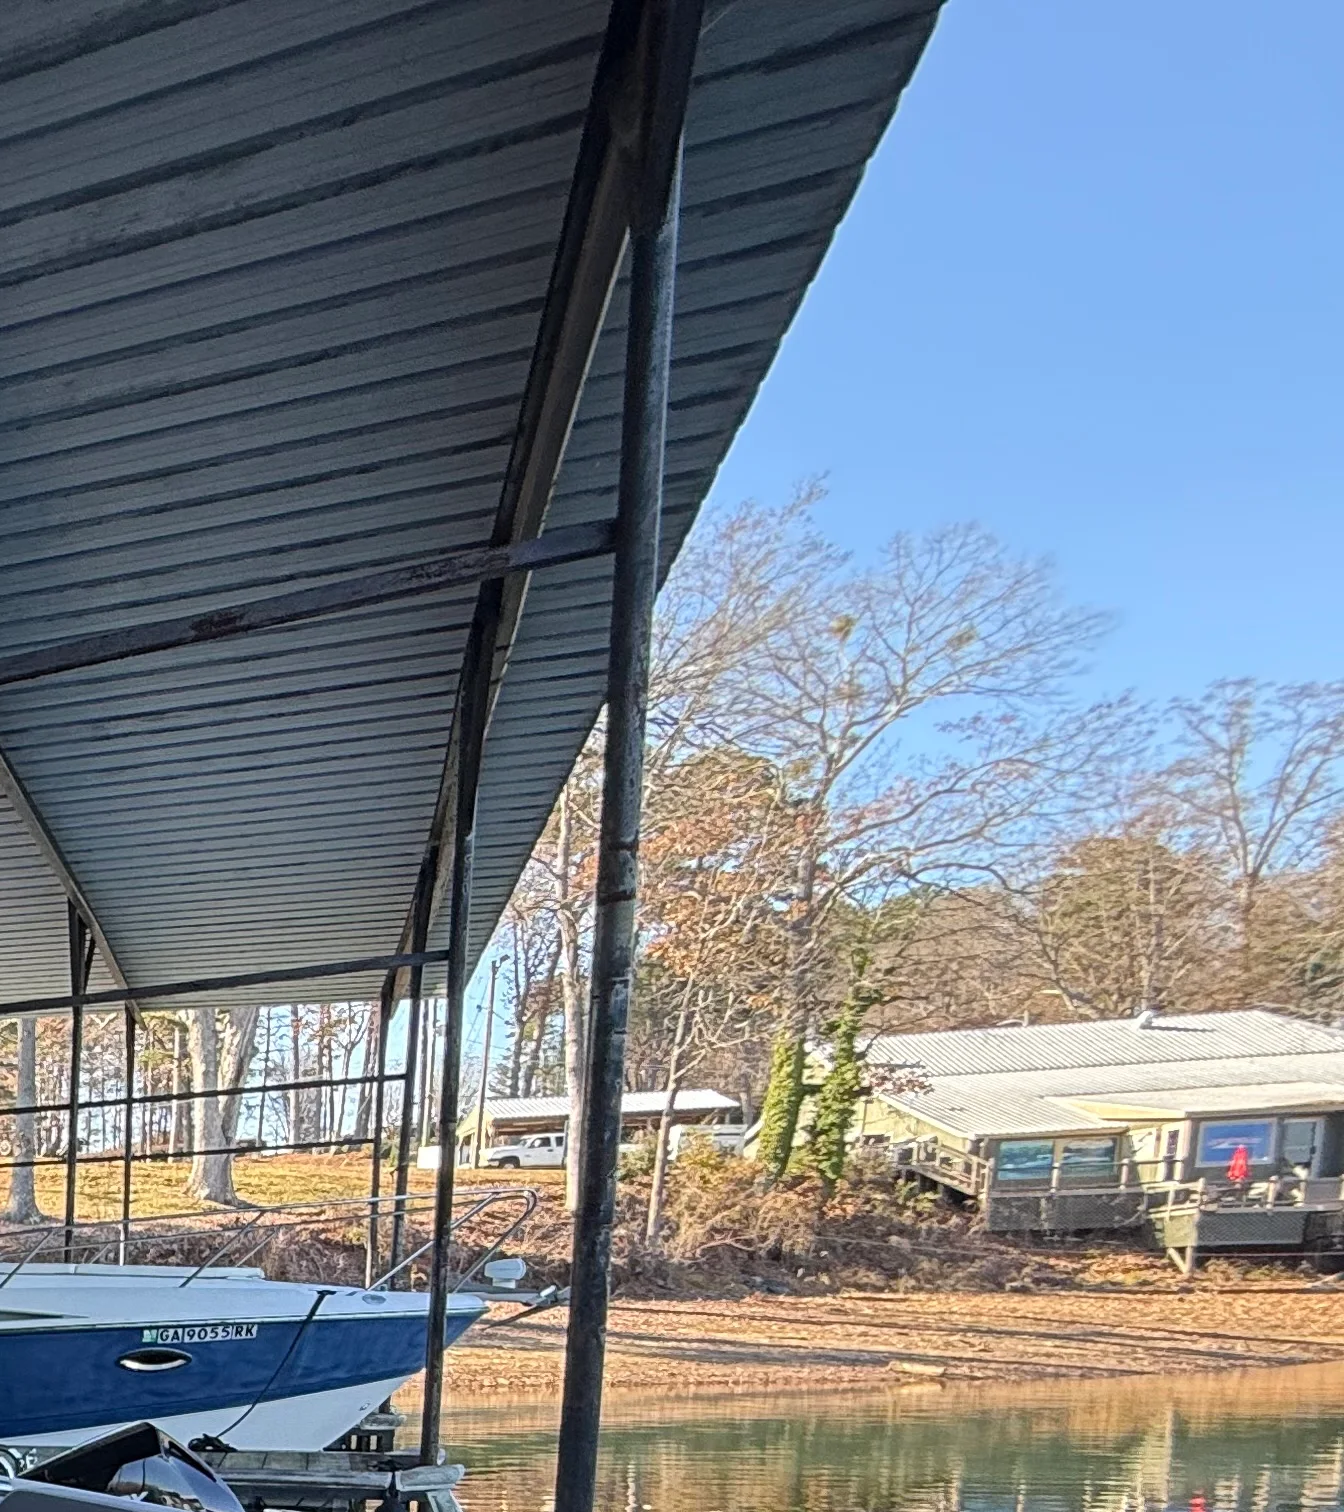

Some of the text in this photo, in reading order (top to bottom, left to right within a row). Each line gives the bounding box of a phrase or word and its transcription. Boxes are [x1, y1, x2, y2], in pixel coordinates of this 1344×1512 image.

[159, 1324, 255, 1342] GA 9055 RK
